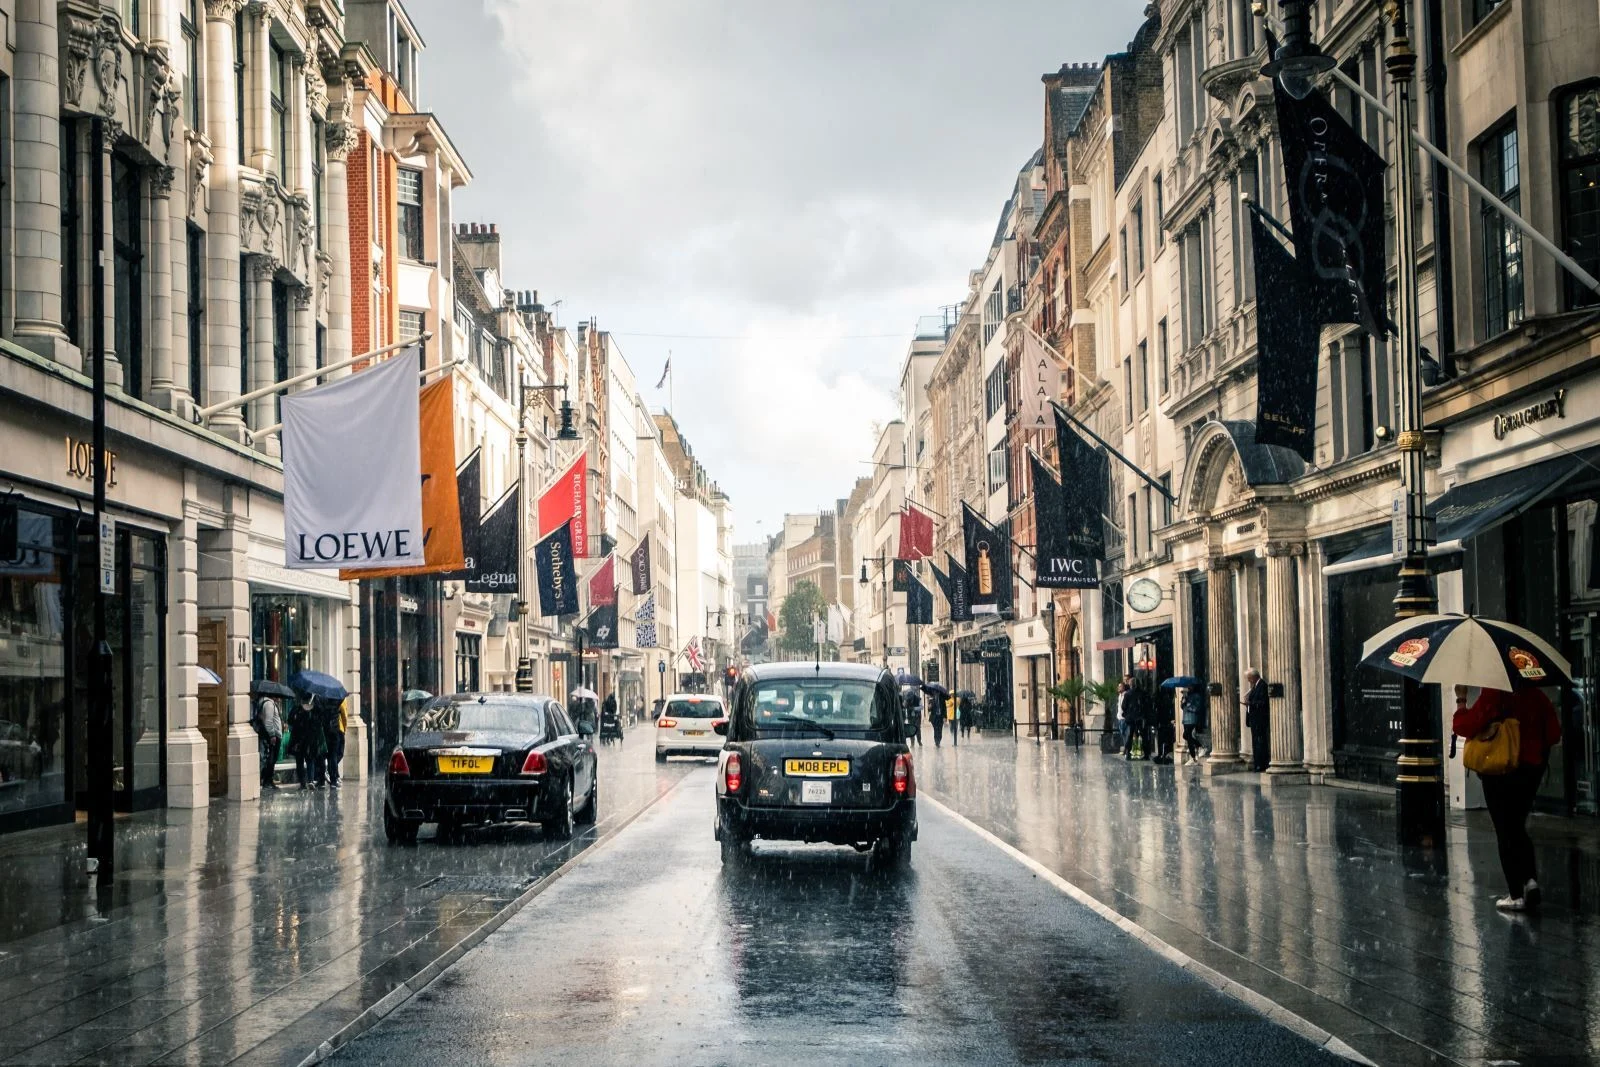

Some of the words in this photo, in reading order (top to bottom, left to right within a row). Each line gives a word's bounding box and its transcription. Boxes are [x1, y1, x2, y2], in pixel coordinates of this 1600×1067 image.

[65, 436, 118, 488] LOEE
[299, 529, 411, 560] LOEWE
[574, 521, 583, 554] GREEN
[637, 548, 647, 572] CHOO
[1050, 558, 1083, 574] IWC
[468, 571, 518, 588] egna
[1038, 575, 1097, 583] SCHAFFHAUSEN
[822, 761, 844, 772] EPL
